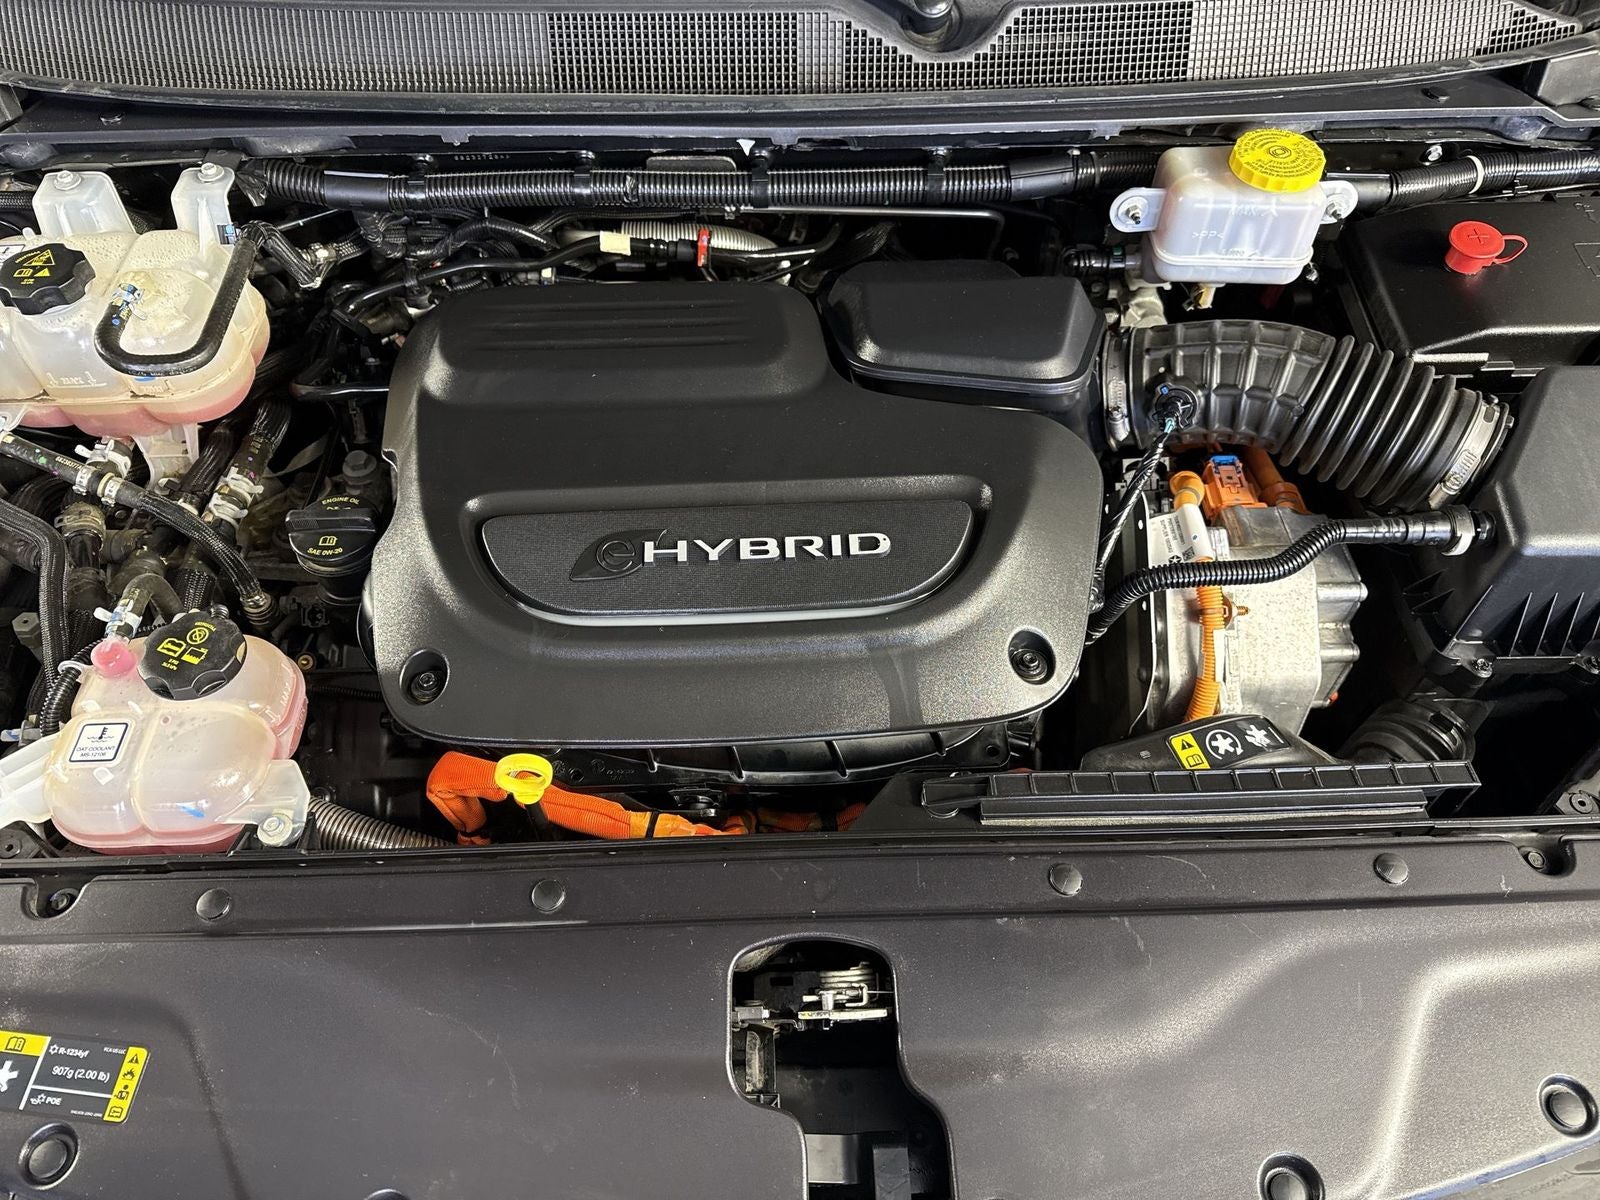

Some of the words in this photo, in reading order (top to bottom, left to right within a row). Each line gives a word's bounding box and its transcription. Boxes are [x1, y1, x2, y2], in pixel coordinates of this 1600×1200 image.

[322, 497, 348, 505] ENGINE
[349, 497, 360, 505] OIL
[306, 547, 322, 555] SAE
[322, 547, 343, 556] 0W-20
[58, 1047, 90, 1059] R-1234yf
[51, 1065, 75, 1080] 907g
[74, 1068, 97, 1081] (2.00
[97, 1071, 110, 1083] lb)
[45, 1096, 62, 1106] POE
